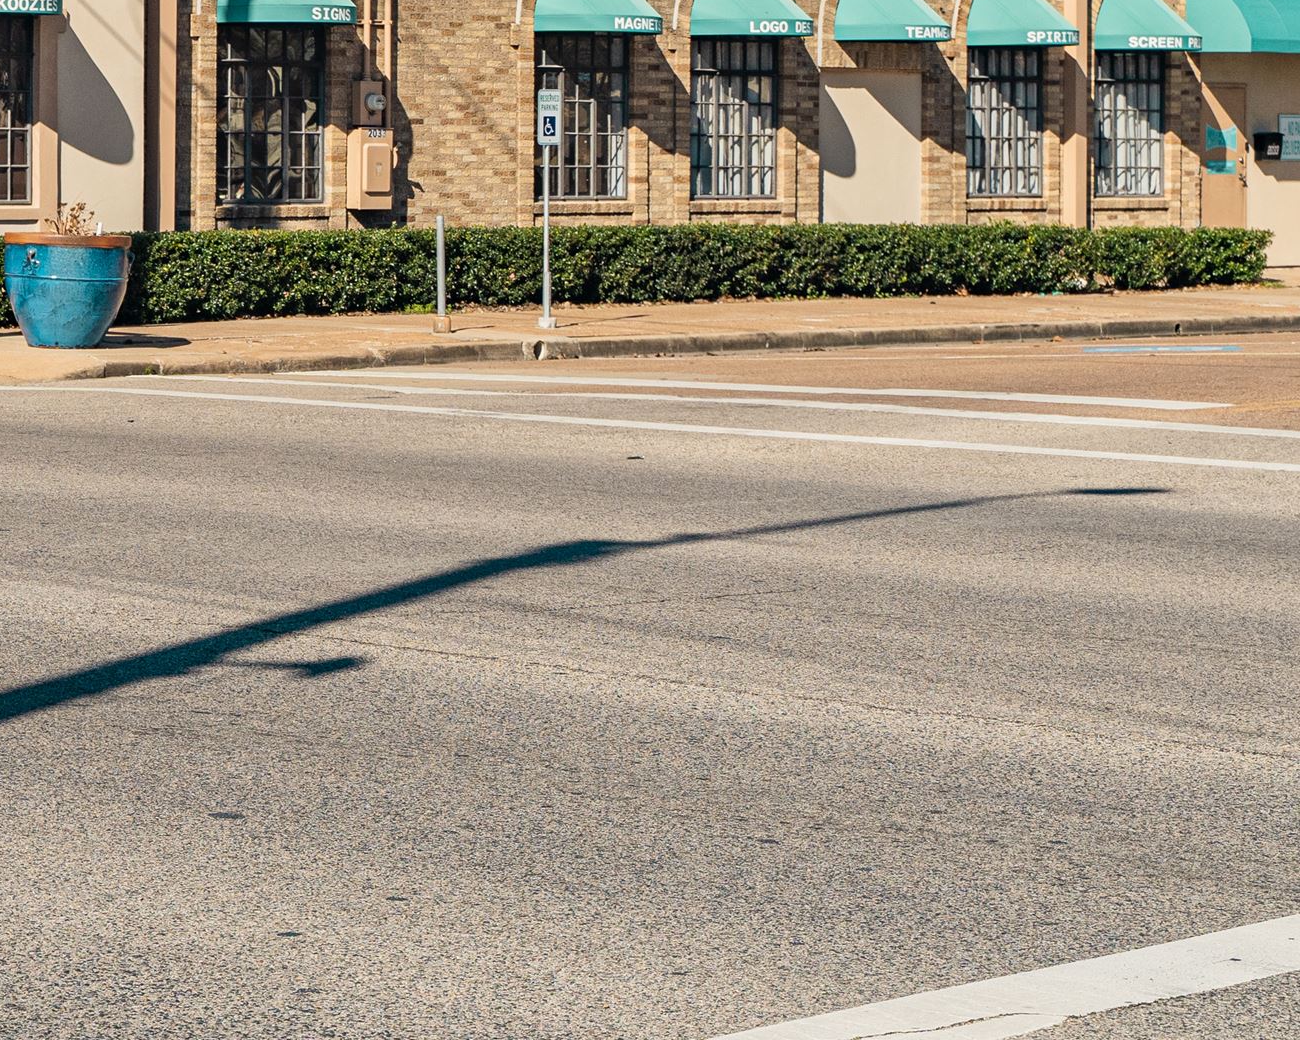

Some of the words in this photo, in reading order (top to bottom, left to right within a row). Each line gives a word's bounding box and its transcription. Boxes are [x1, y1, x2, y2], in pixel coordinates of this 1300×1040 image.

[311, 6, 352, 22] SIGNS
[749, 20, 789, 33] LOGO
[1128, 36, 1183, 49] SCREEN
[540, 94, 560, 103] RESERVED
[540, 104, 559, 112] PARKING
